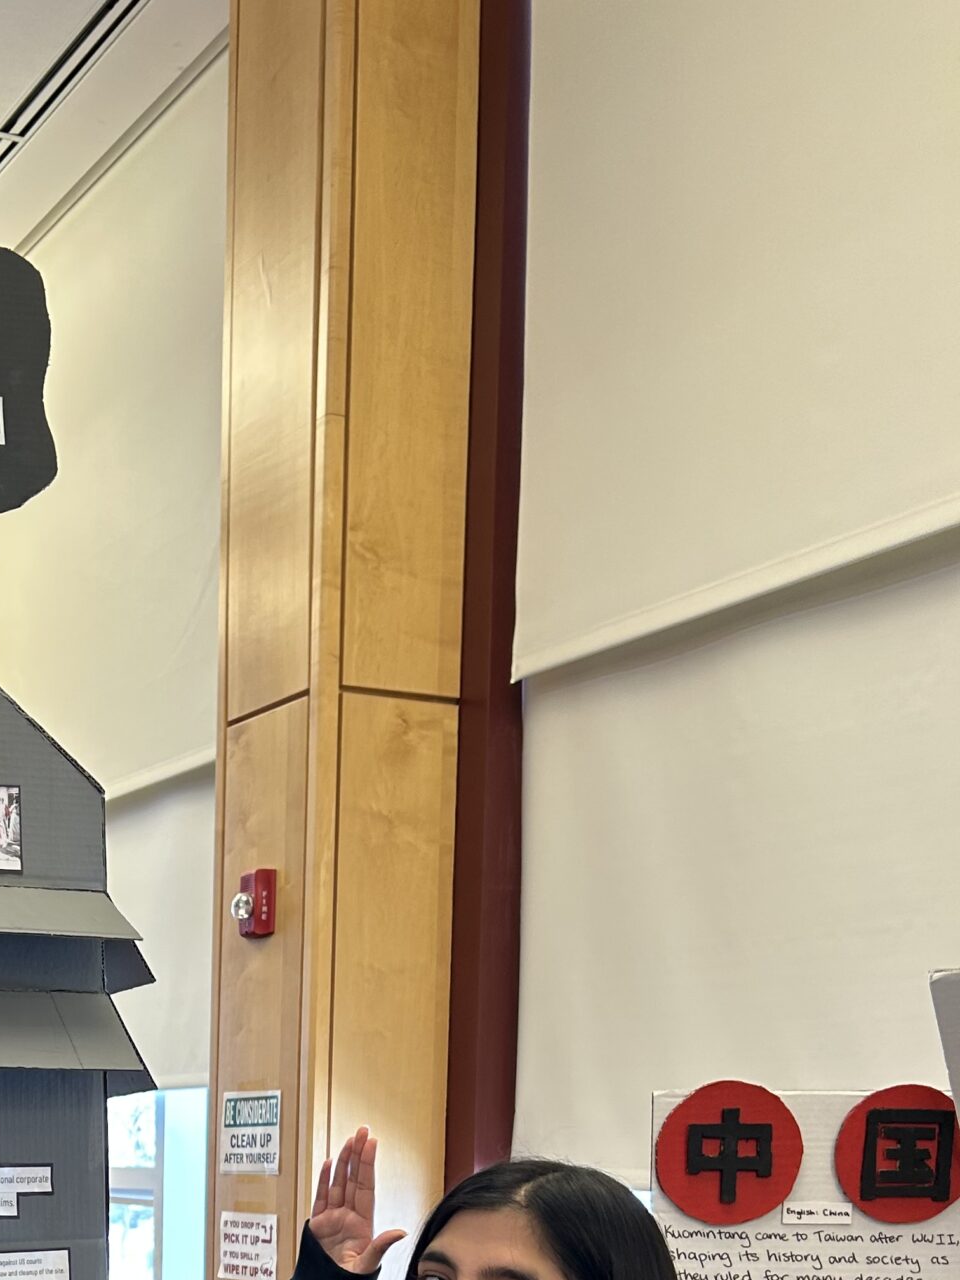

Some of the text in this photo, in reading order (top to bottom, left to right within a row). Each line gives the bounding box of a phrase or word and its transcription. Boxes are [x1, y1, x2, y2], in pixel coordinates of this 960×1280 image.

[225, 1099, 277, 1124] BE CONSIDERATE
[231, 1134, 271, 1149] CLEAN UP
[224, 1153, 276, 1164] AFTER YOURSELF
[16, 1175, 48, 1185] corporate
[786, 1207, 850, 1220] English: China
[230, 1220, 239, 1228] YOU
[224, 1233, 260, 1244] PICK IT UP
[665, 1225, 750, 1247] Kuomintang
[755, 1233, 787, 1241] came
[792, 1233, 807, 1241] to
[814, 1231, 863, 1242] Taiwan
[870, 1232, 902, 1244] after
[230, 1251, 239, 1259] YOU
[669, 1250, 948, 1272] shaping its history and society as
[224, 1264, 259, 1277] WIPE IT UP
